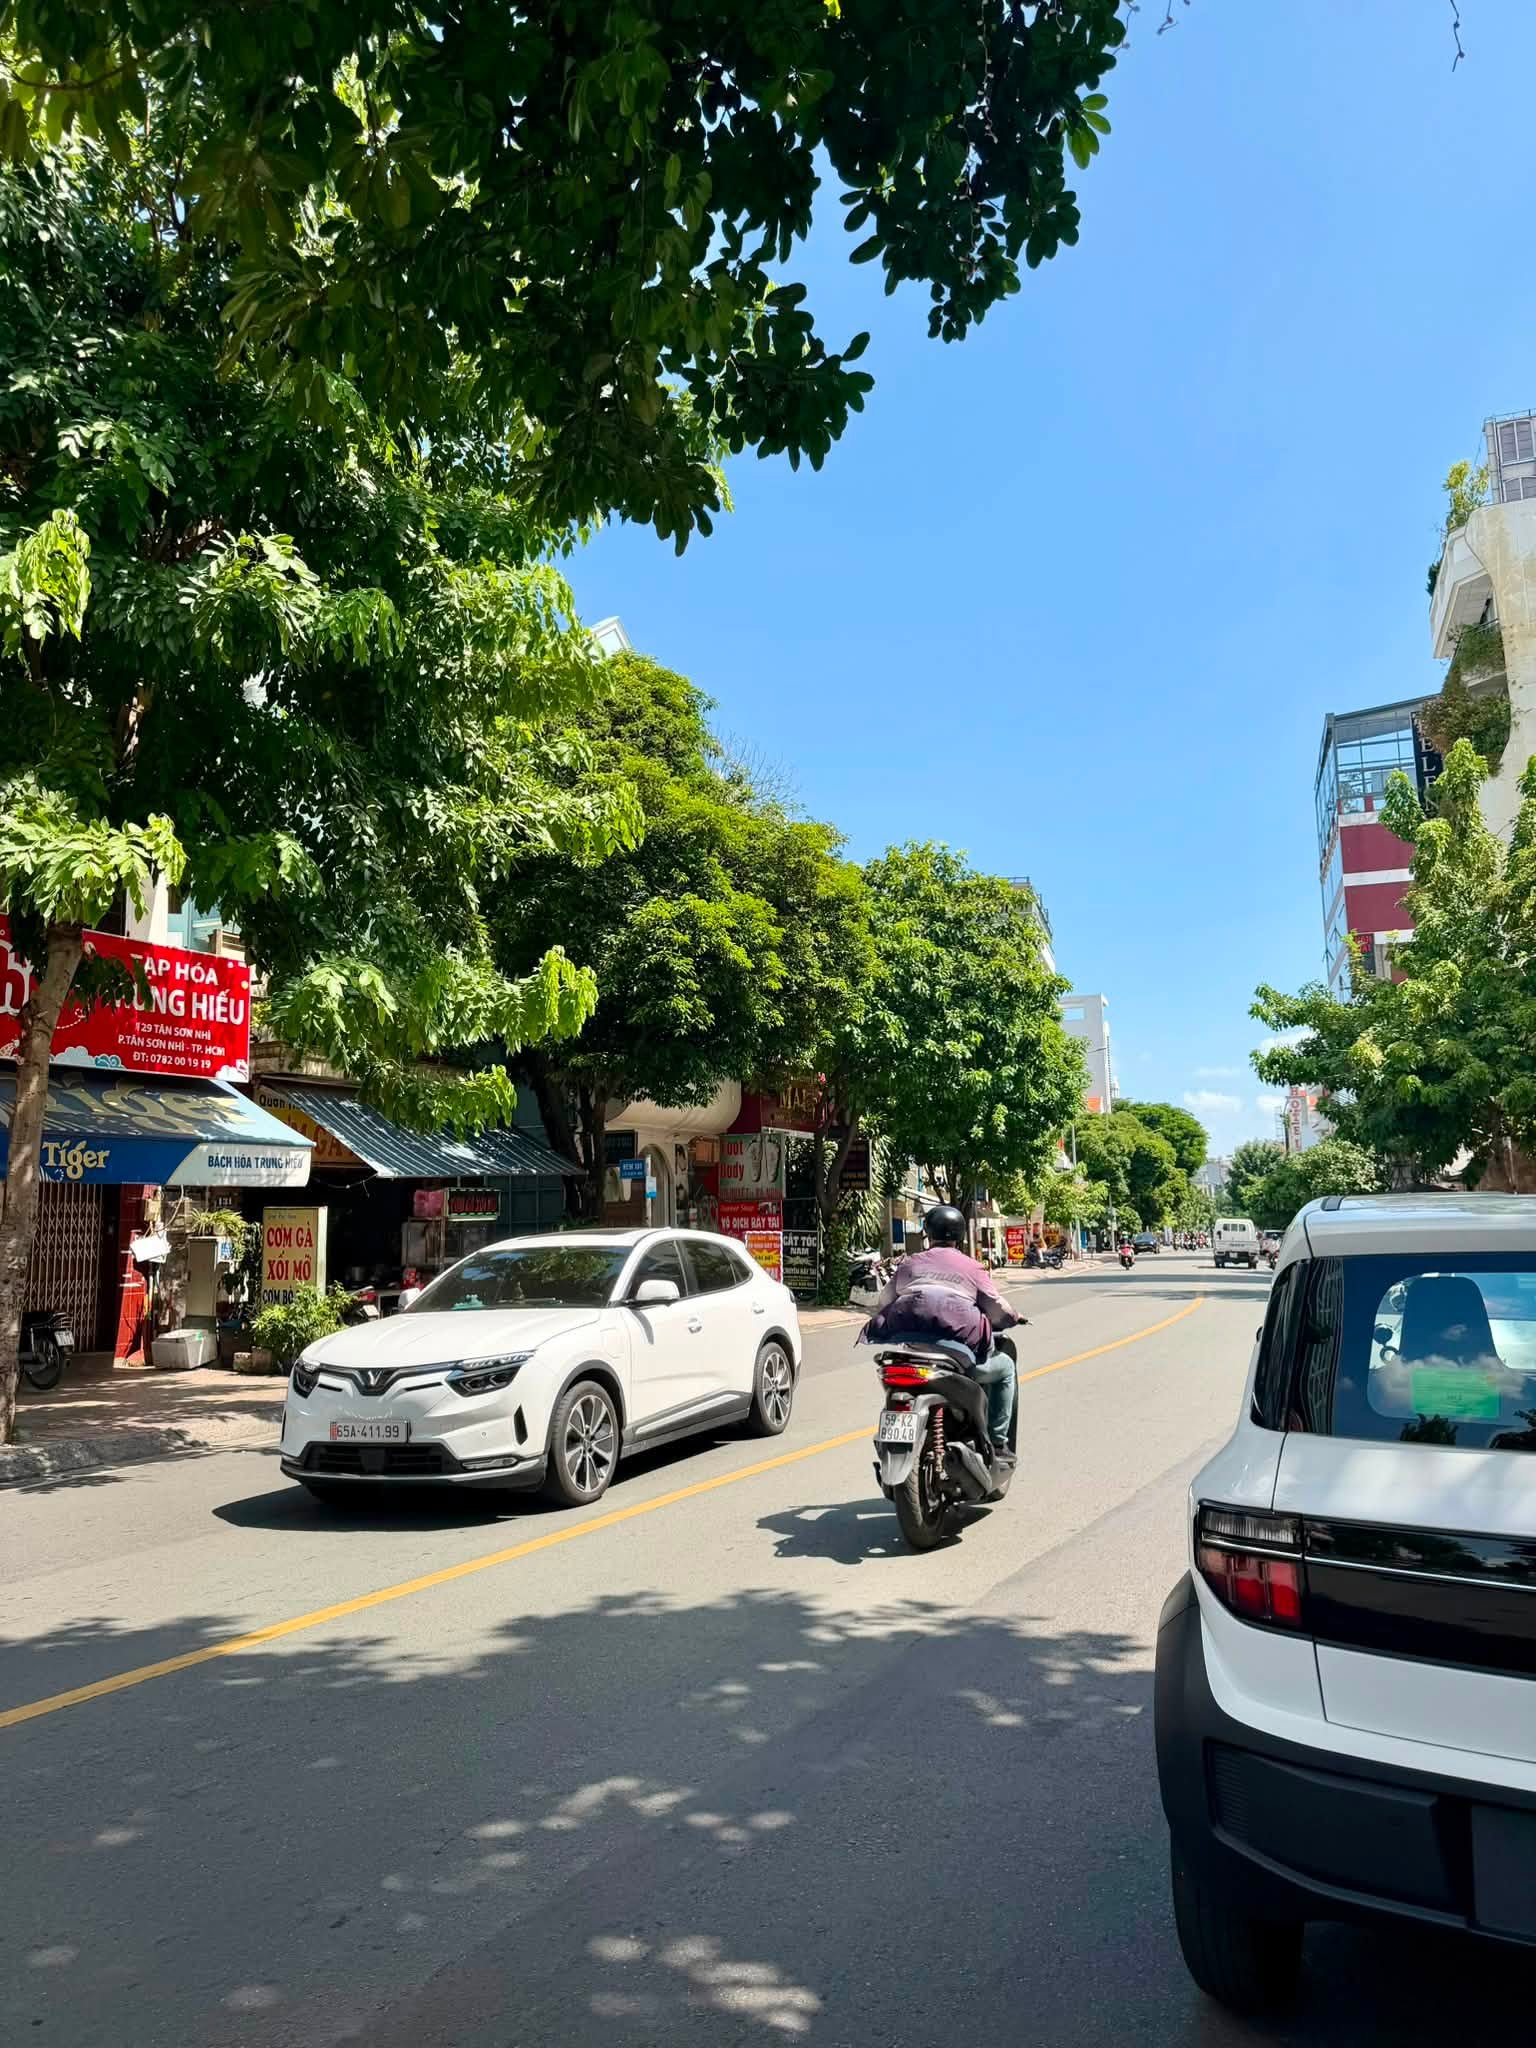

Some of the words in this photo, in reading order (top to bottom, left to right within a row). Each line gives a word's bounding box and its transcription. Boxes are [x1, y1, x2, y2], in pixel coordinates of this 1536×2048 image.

[175, 962, 219, 986] HÓA
[191, 988, 245, 1026] HIẾU
[154, 1024, 173, 1036] TÂN
[174, 1026, 194, 1039] SƠN
[117, 1034, 145, 1047] P.TÂN
[146, 1037, 166, 1050] SƠN
[167, 1040, 185, 1052] NHÌ
[191, 1043, 204, 1054] TP.
[204, 1046, 226, 1057] HCM
[133, 1050, 149, 1063] ĐT:
[150, 1053, 173, 1066] 0782
[173, 1057, 186, 1067] 00
[187, 1058, 199, 1068] 19
[200, 1059, 212, 1069] 19
[41, 1139, 111, 1180] Tiger
[207, 1152, 232, 1169] BÁCH
[234, 1153, 253, 1169] HÓA
[254, 1156, 284, 1169] TRUNG
[266, 1223, 293, 1248] CƠM
[295, 1220, 313, 1248] GÀ
[801, 1233, 817, 1247] TÓC
[336, 1424, 400, 1439] 65A-411.99
